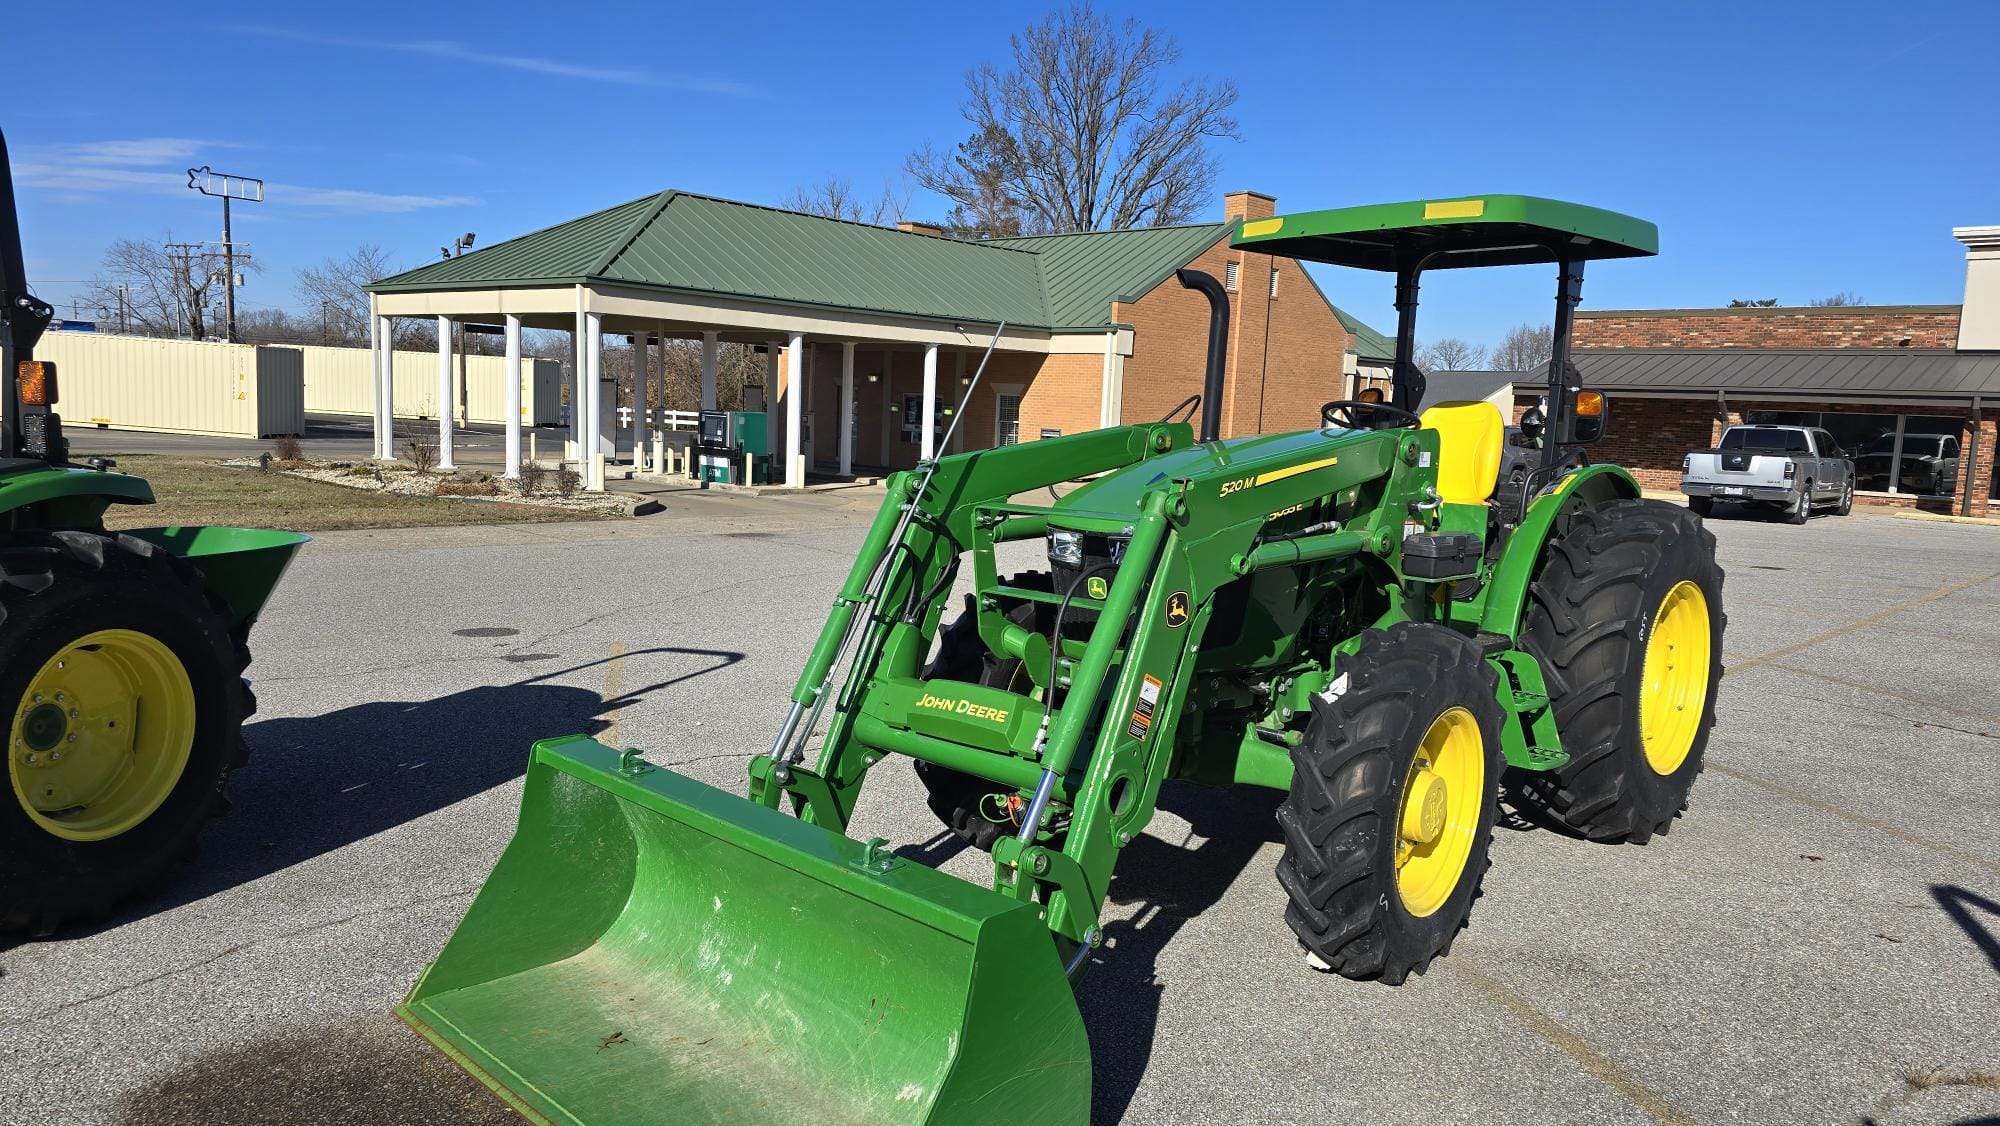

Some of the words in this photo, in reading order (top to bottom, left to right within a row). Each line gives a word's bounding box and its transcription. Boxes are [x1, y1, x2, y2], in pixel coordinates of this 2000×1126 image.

[708, 468, 722, 478] ATM
[916, 693, 956, 712] JOHN
[956, 699, 1009, 723] DEERE
